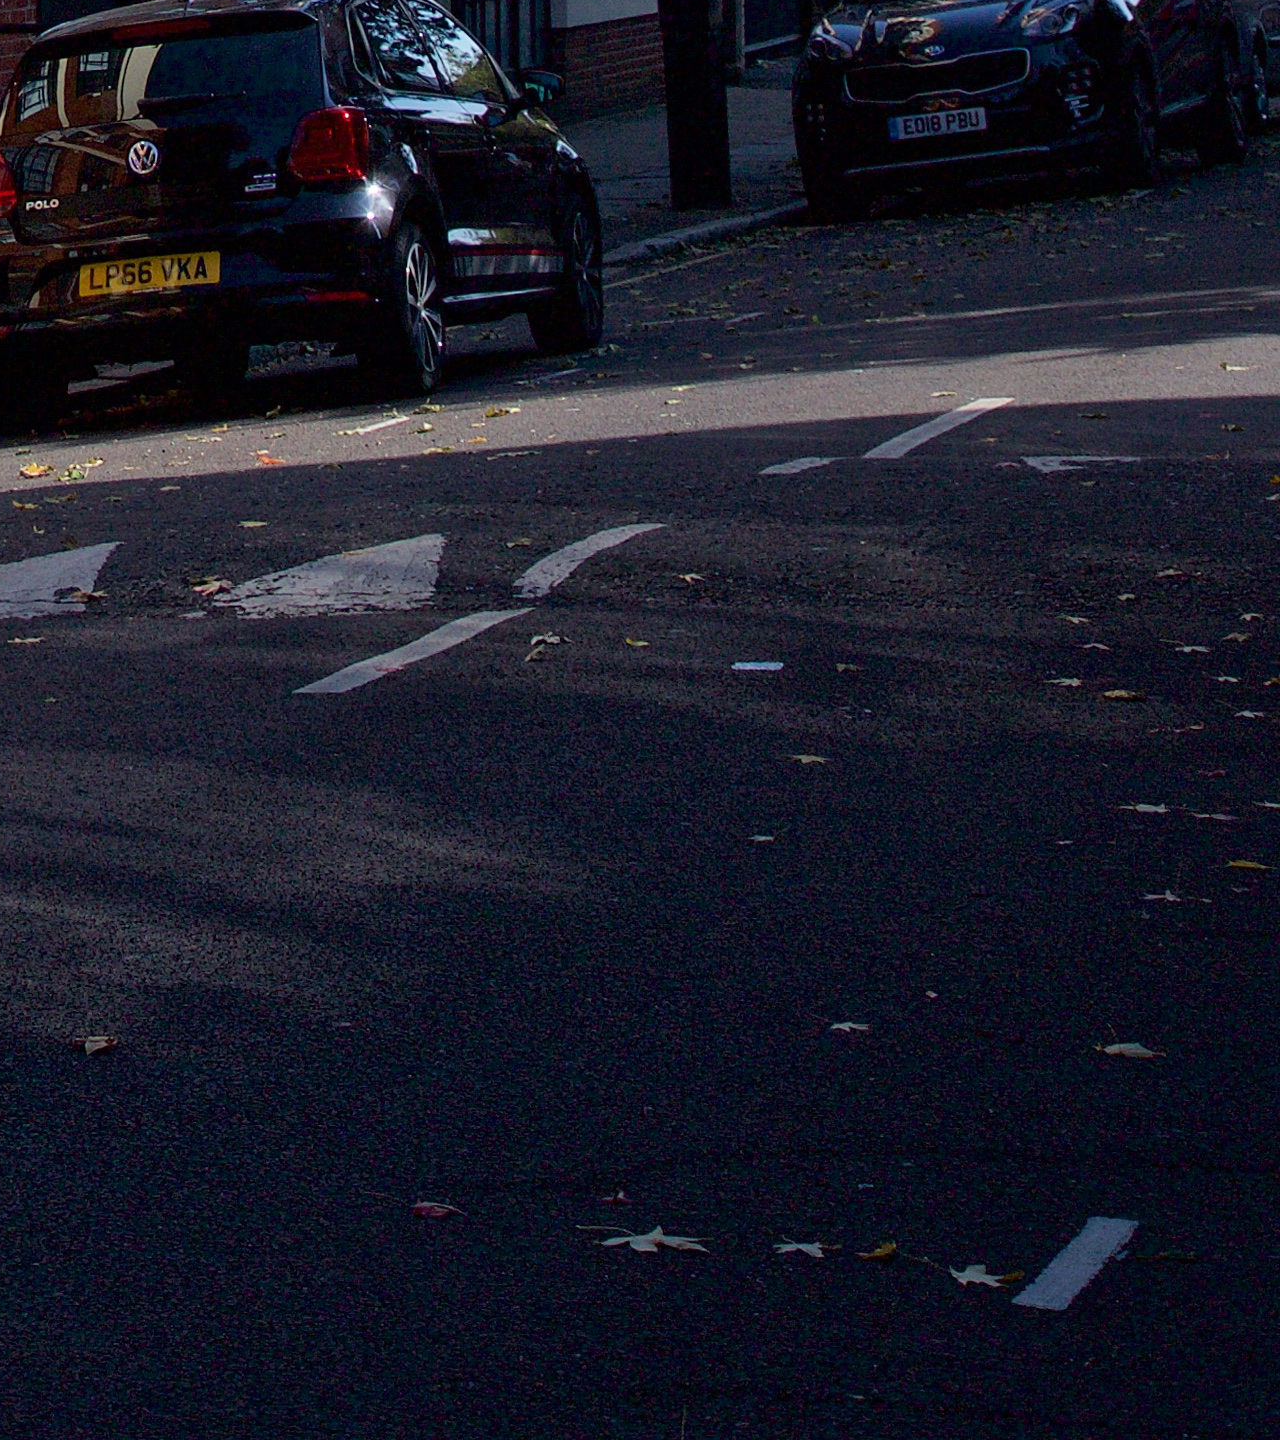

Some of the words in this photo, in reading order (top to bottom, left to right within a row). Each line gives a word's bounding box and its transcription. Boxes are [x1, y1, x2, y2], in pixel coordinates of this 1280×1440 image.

[946, 111, 980, 130] PBU
[25, 198, 59, 211] POLO
[160, 256, 207, 281] VKA
